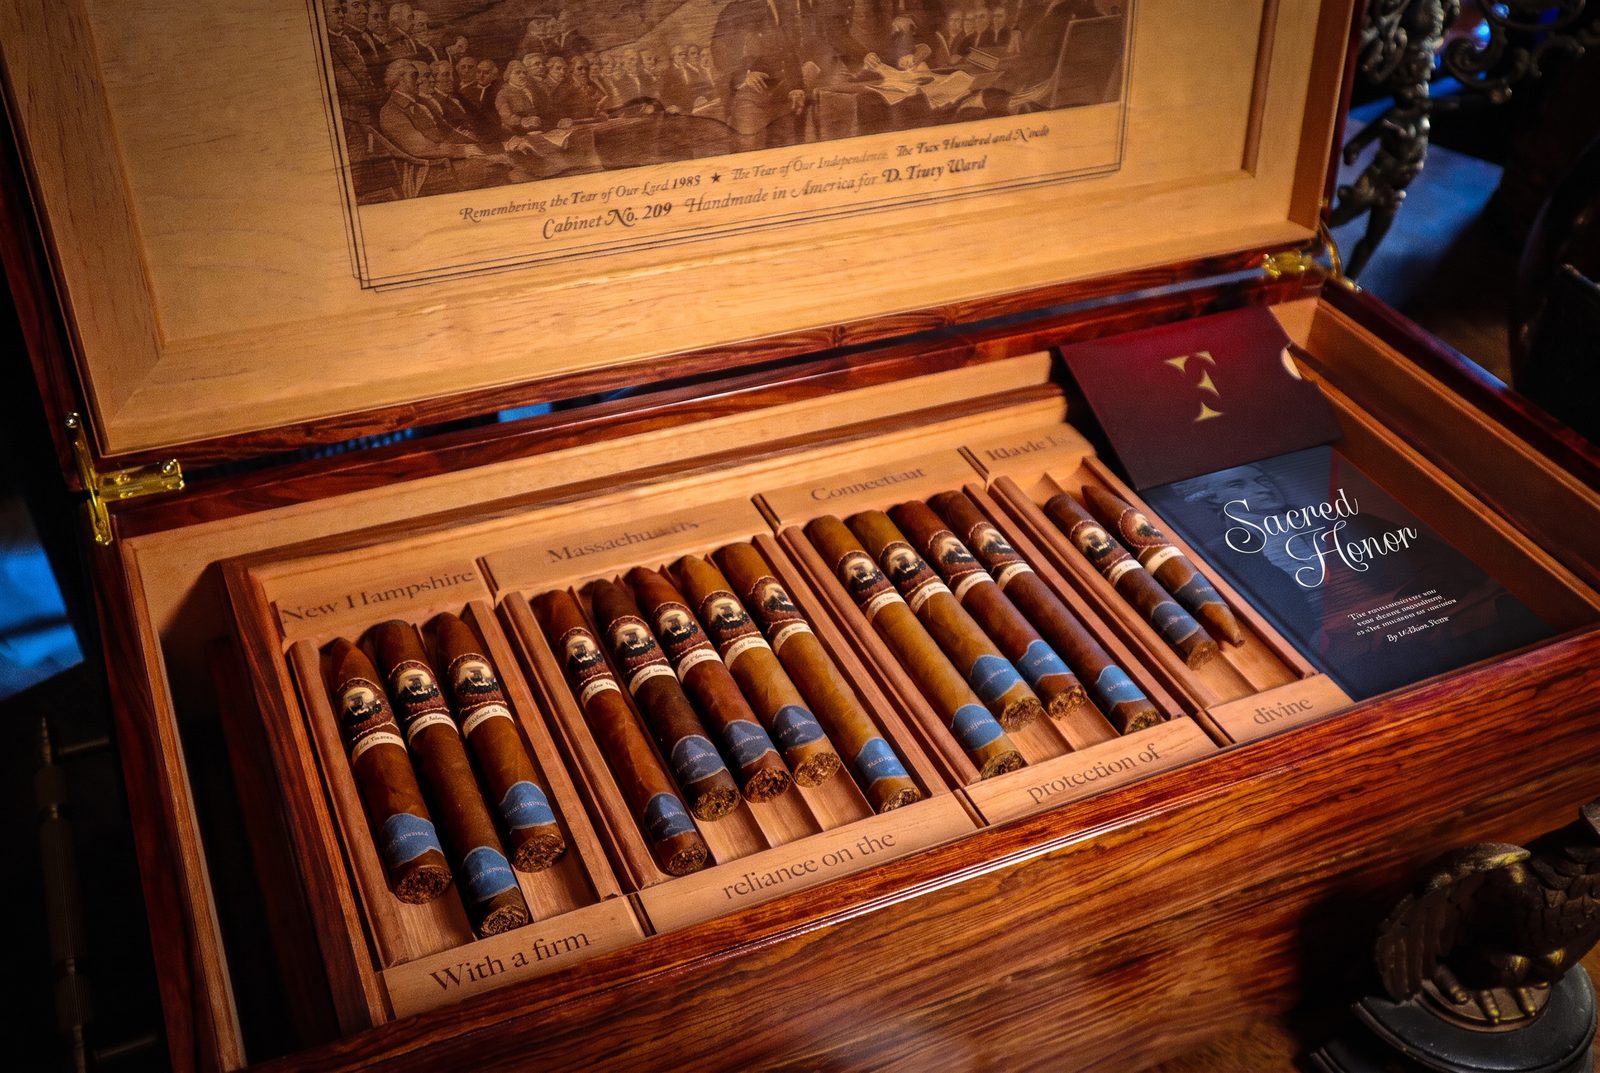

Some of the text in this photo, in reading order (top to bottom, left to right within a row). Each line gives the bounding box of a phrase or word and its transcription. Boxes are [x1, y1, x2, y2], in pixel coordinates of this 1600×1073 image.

[459, 199, 547, 223] Remembering
[550, 194, 568, 208] the
[601, 186, 615, 204] of
[615, 185, 640, 198] Our
[543, 214, 604, 240] Cabinet
[604, 206, 639, 228] No.
[642, 201, 673, 220] 209
[684, 188, 769, 213] Handmade
[772, 186, 787, 200] in
[790, 176, 855, 198] America
[854, 172, 879, 193] for
[882, 167, 903, 183] D.
[947, 155, 988, 174] Ward
[547, 521, 700, 564] Massachu
[1223, 488, 1359, 554] Sacred
[1285, 520, 1418, 588] Honor
[281, 571, 475, 624] New Hampshire
[1252, 695, 1314, 726] divine
[1026, 742, 1163, 805] protection of
[722, 830, 897, 900] reliance on the
[429, 930, 591, 991] With a firm
